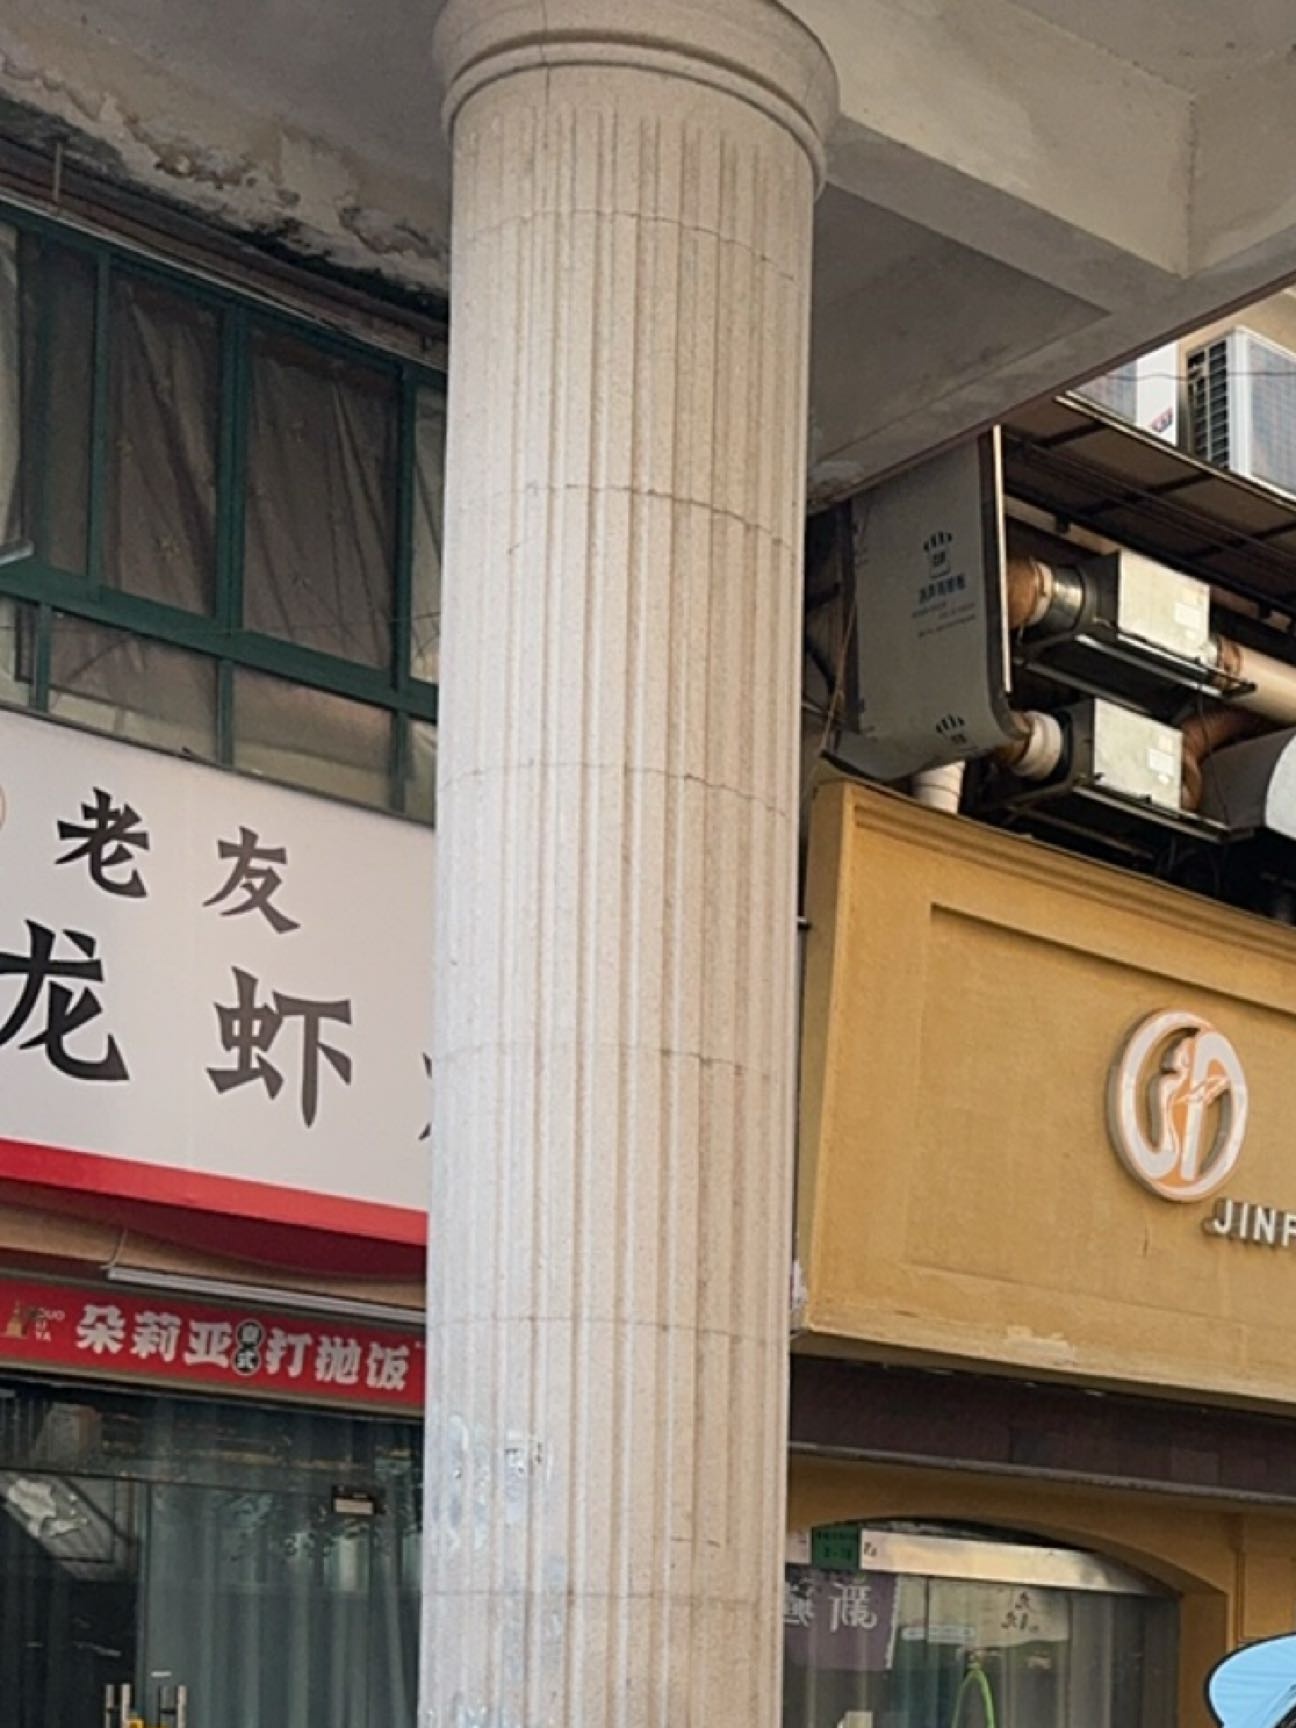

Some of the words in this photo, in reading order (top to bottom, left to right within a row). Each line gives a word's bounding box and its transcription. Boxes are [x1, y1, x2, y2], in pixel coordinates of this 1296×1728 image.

[55, 786, 300, 934] 老友
[0, 918, 433, 1140] 龙虾
[75, 1303, 232, 1369] 朵莉亚
